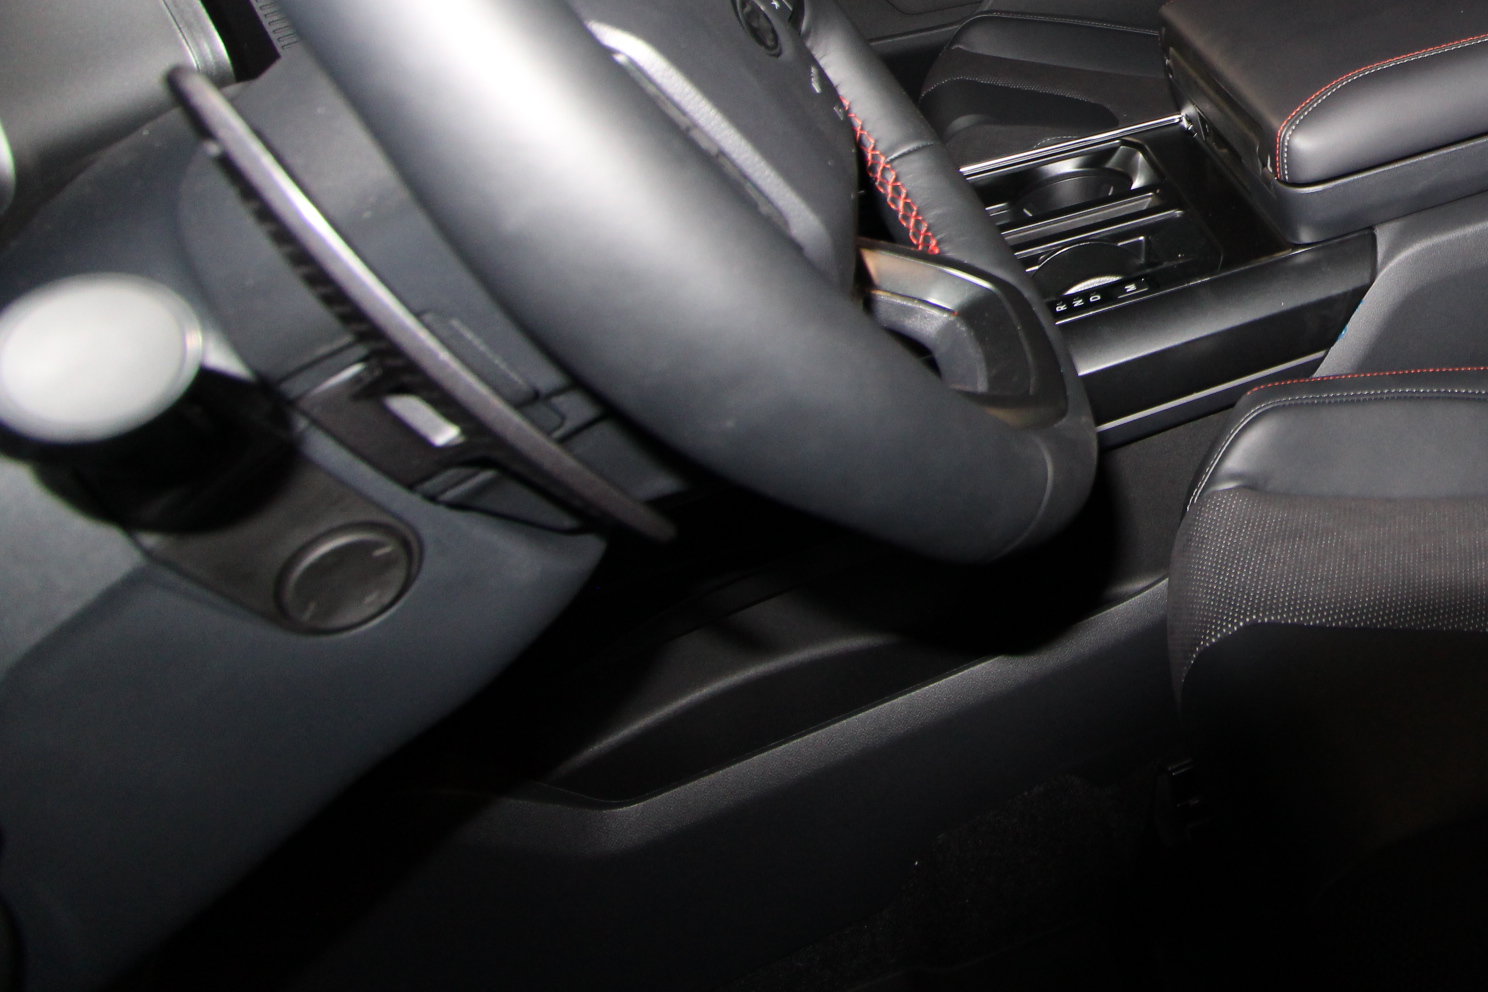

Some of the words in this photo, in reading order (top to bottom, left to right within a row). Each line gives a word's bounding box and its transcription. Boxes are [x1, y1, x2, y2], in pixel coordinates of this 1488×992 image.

[1056, 303, 1067, 312] R
[1072, 298, 1084, 307] N
[1089, 294, 1101, 302] D
